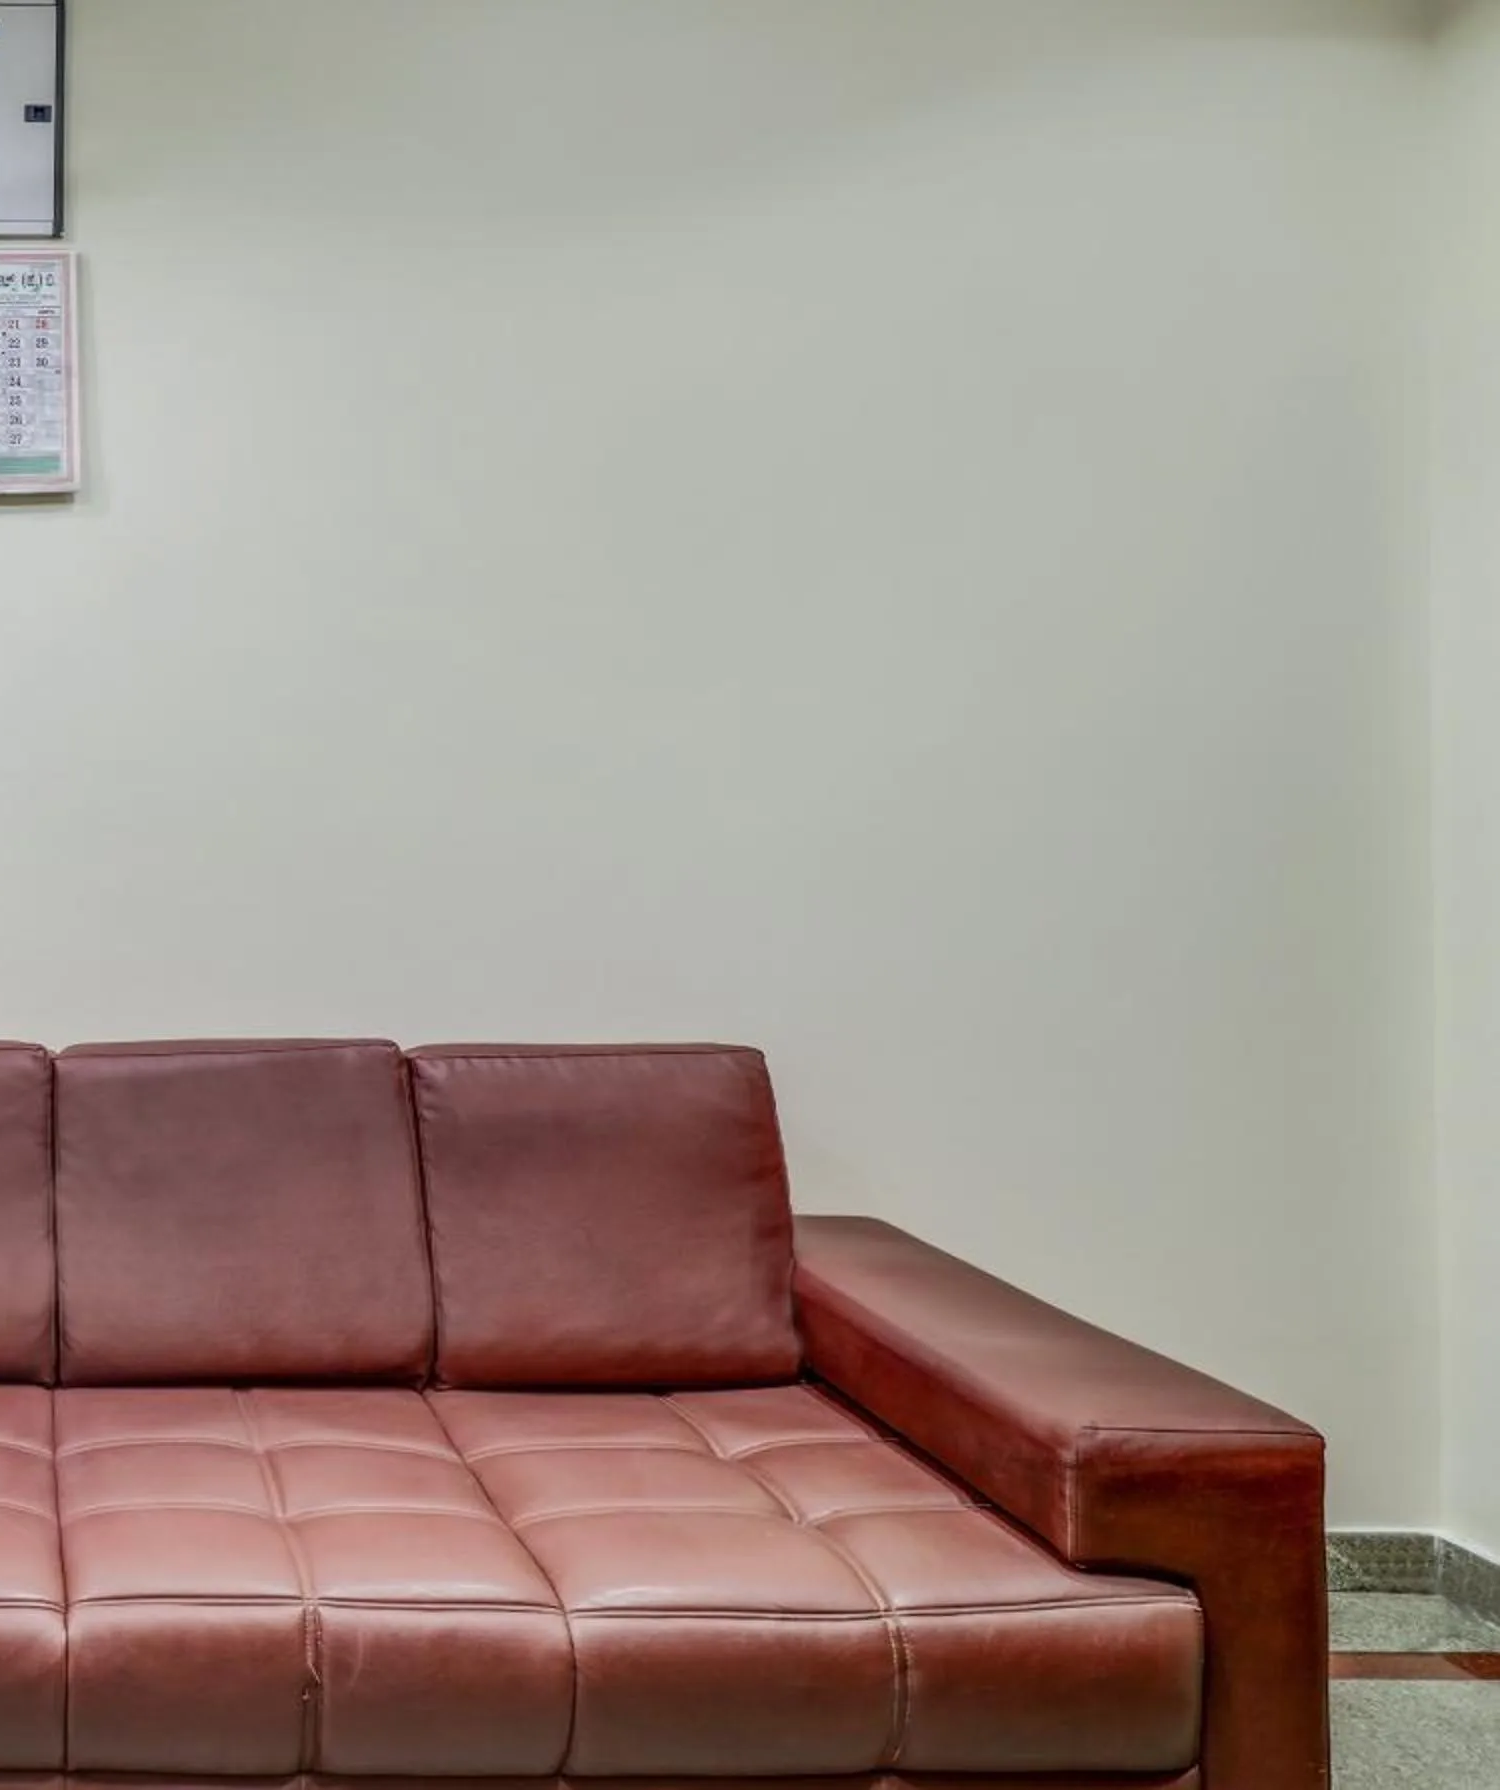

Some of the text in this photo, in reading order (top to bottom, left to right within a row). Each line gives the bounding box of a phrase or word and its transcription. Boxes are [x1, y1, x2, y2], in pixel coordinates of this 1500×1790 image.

[7, 319, 20, 330] 21
[7, 339, 21, 349] 22
[35, 339, 49, 349] 29
[35, 358, 49, 369] 30
[8, 377, 21, 388] 24
[9, 433, 23, 445] 27
